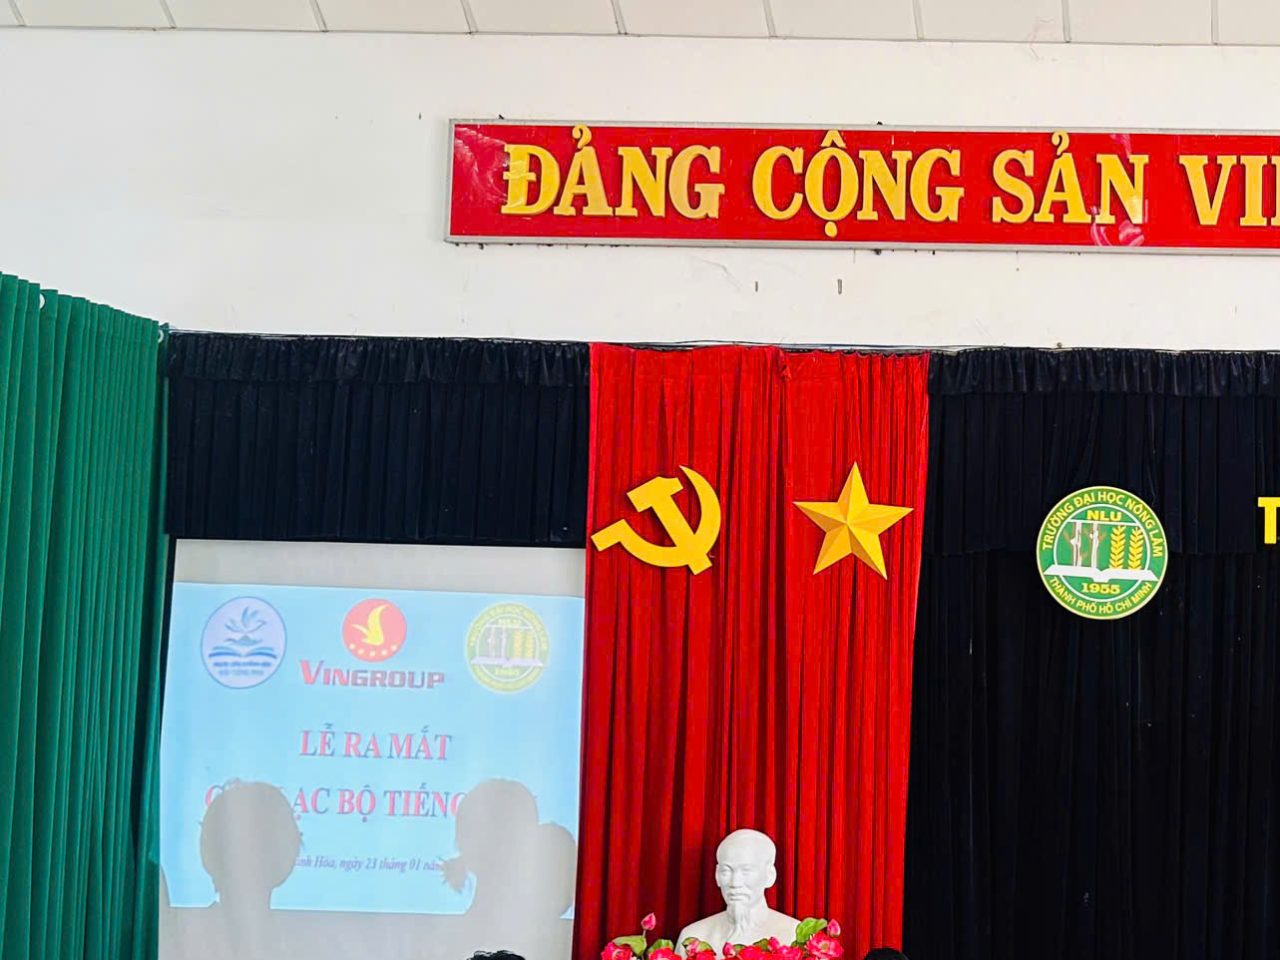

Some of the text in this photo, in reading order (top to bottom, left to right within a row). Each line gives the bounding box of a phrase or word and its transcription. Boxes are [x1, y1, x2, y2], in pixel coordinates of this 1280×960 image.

[500, 123, 725, 218] ĐẢNG
[752, 129, 965, 237] CỘNG
[992, 130, 1149, 225] SẢN
[1073, 492, 1096, 508] ĐẠI
[1098, 491, 1125, 504] HỌC
[1125, 498, 1156, 528] NÔNG
[1086, 510, 1122, 521] NLU
[1081, 583, 1121, 595] 1955
[300, 659, 445, 689] VINGROUP
[300, 722, 453, 760] LỄ RA MẮT
[292, 787, 331, 821] ẠC
[337, 785, 376, 822] BỘ
